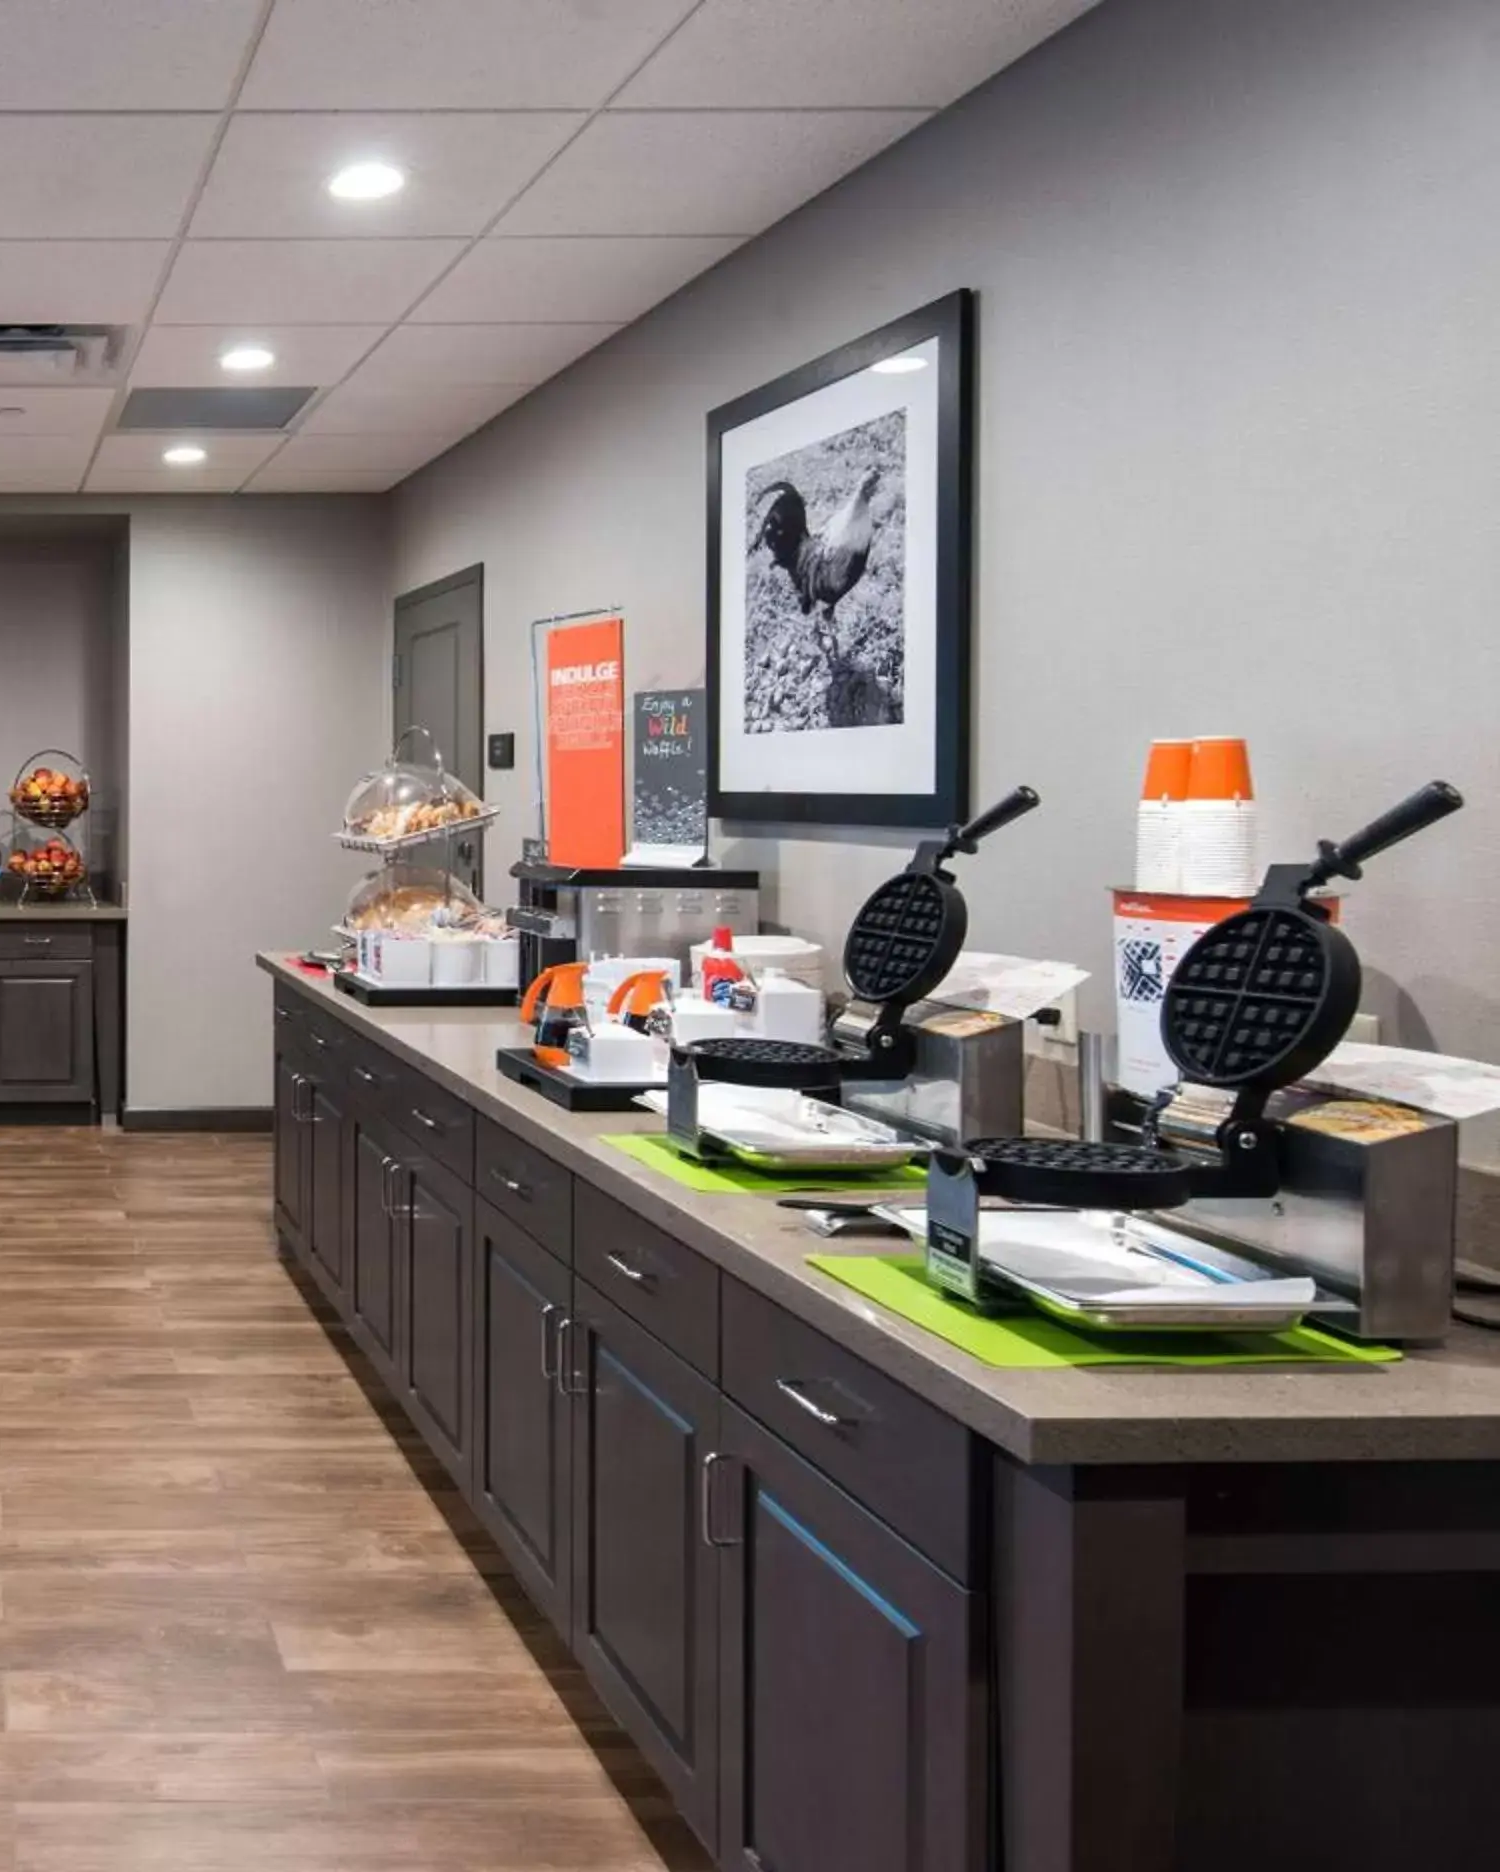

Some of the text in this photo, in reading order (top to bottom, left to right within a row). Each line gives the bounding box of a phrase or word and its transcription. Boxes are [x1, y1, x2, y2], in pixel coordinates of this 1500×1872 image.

[551, 660, 620, 687] INDULGE
[641, 696, 692, 718] Enjoy a
[648, 714, 688, 737] Wild
